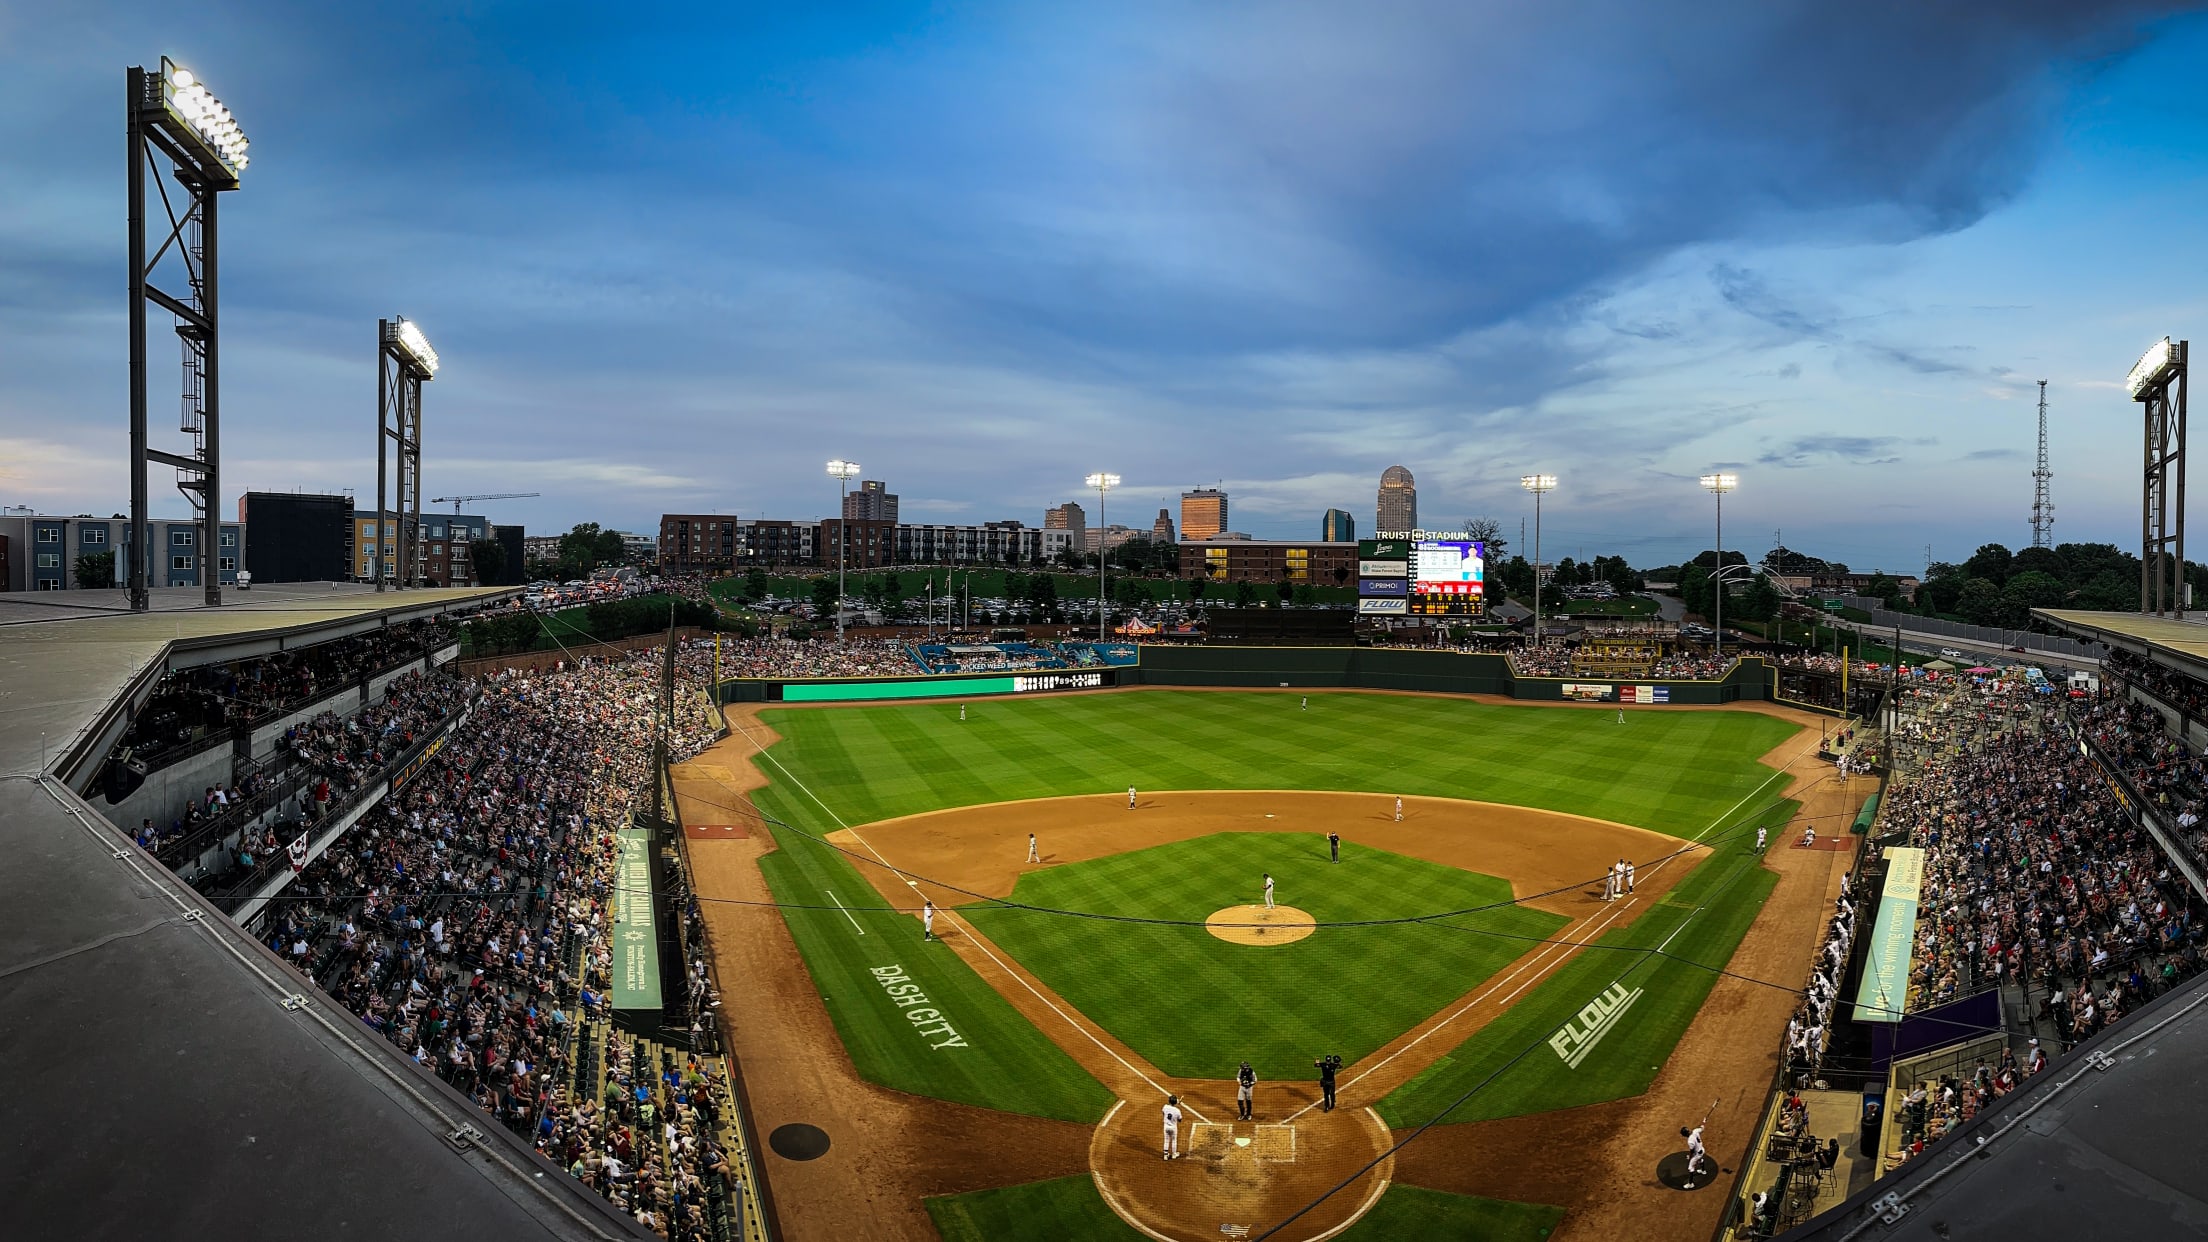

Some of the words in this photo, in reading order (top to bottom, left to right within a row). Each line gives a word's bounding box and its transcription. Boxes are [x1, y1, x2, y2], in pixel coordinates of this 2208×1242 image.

[1376, 531, 1410, 540] TRUIST
[1426, 532, 1468, 540] STADIUM
[630, 896, 651, 926] CAROLINAS
[1890, 903, 1906, 931] moments
[636, 945, 646, 959] Proudly
[1883, 932, 1905, 962] winning
[637, 960, 646, 984] Homegrown
[1876, 964, 1895, 978] the
[1872, 980, 1893, 993] for
[870, 964, 930, 1008] DASH
[906, 1008, 968, 1050] CITY
[1548, 981, 1630, 1059] FLOW
